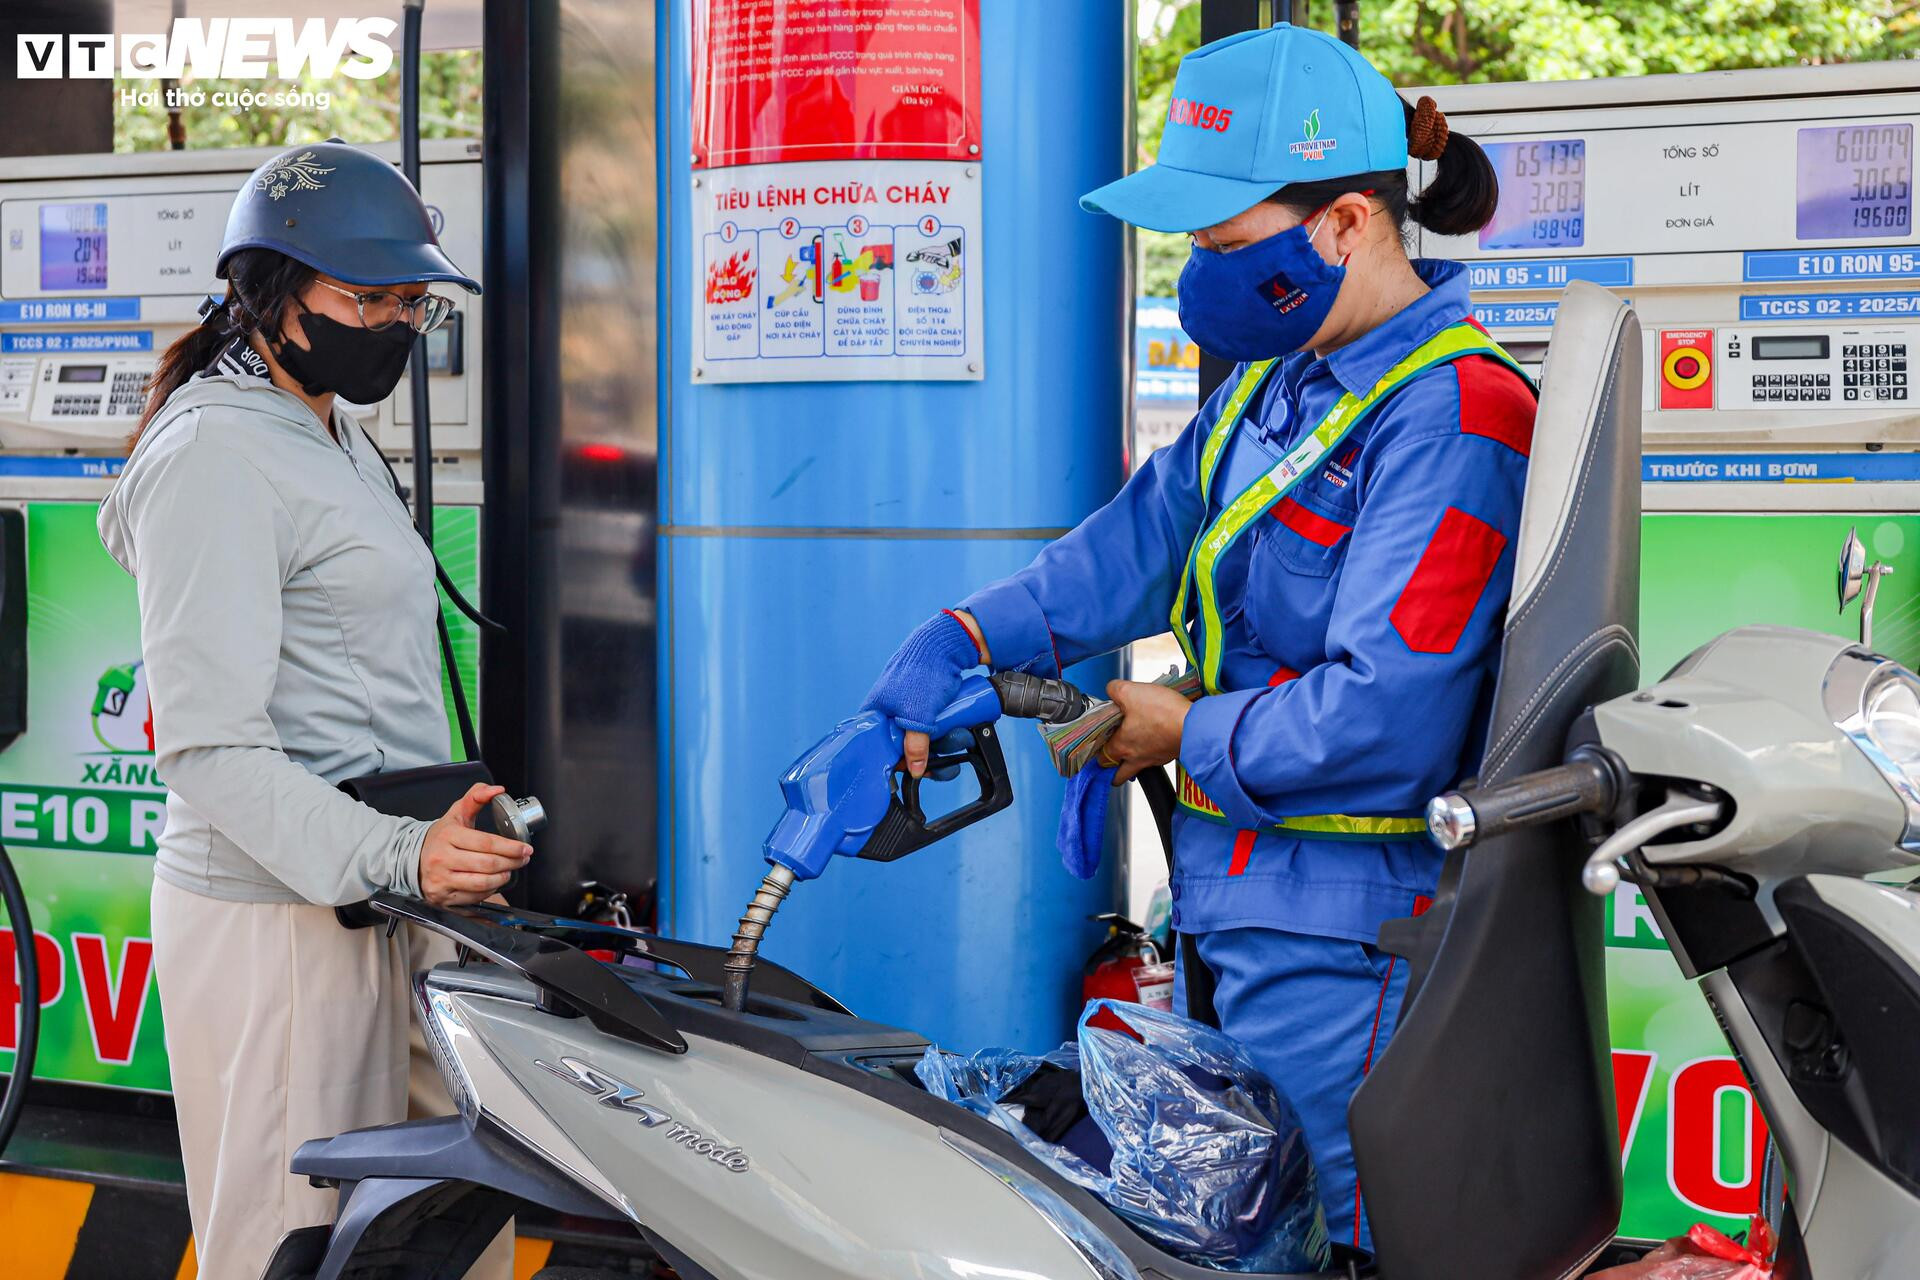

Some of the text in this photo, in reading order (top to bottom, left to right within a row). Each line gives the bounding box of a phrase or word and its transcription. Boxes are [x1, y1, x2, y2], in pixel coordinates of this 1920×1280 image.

[830, 50, 855, 61] PCCC
[781, 68, 805, 78] PCCC
[1290, 139, 1336, 153] PETROVIETNAM
[1663, 143, 1720, 159] TỔNG SỐ
[1516, 144, 1582, 177] 65135
[715, 181, 951, 213] TIÊU LỆNH CHỮA CHÁY
[1680, 183, 1701, 197] LÍT
[1666, 215, 1715, 229] ĐƠN GIÁ
[1853, 205, 1908, 228] 19600
[726, 218, 934, 239] 1 2 3 4
[1532, 218, 1582, 239] 19840
[1798, 256, 1835, 275] E10
[1841, 255, 1883, 274] RON
[1506, 267, 1529, 284] 95
[1547, 266, 1567, 283] III
[1759, 300, 1810, 315] TCCS
[1816, 299, 1841, 314] 02
[12, 336, 43, 349] TCCS
[1845, 345, 1854, 354] 7
[1862, 345, 1870, 354] 8
[1878, 345, 1887, 354] 9
[241, 345, 269, 376] DIOR
[1846, 360, 1855, 368] 4
[1863, 360, 1871, 368] 5
[1878, 360, 1887, 368] 6
[1863, 374, 1871, 382] 2
[1879, 374, 1887, 382] 3
[1863, 390, 1871, 399] C
[1650, 461, 1818, 477] TRƯỚC KHI BƠM
[1, 791, 109, 846] E10
[665, 1120, 750, 1173] mode
